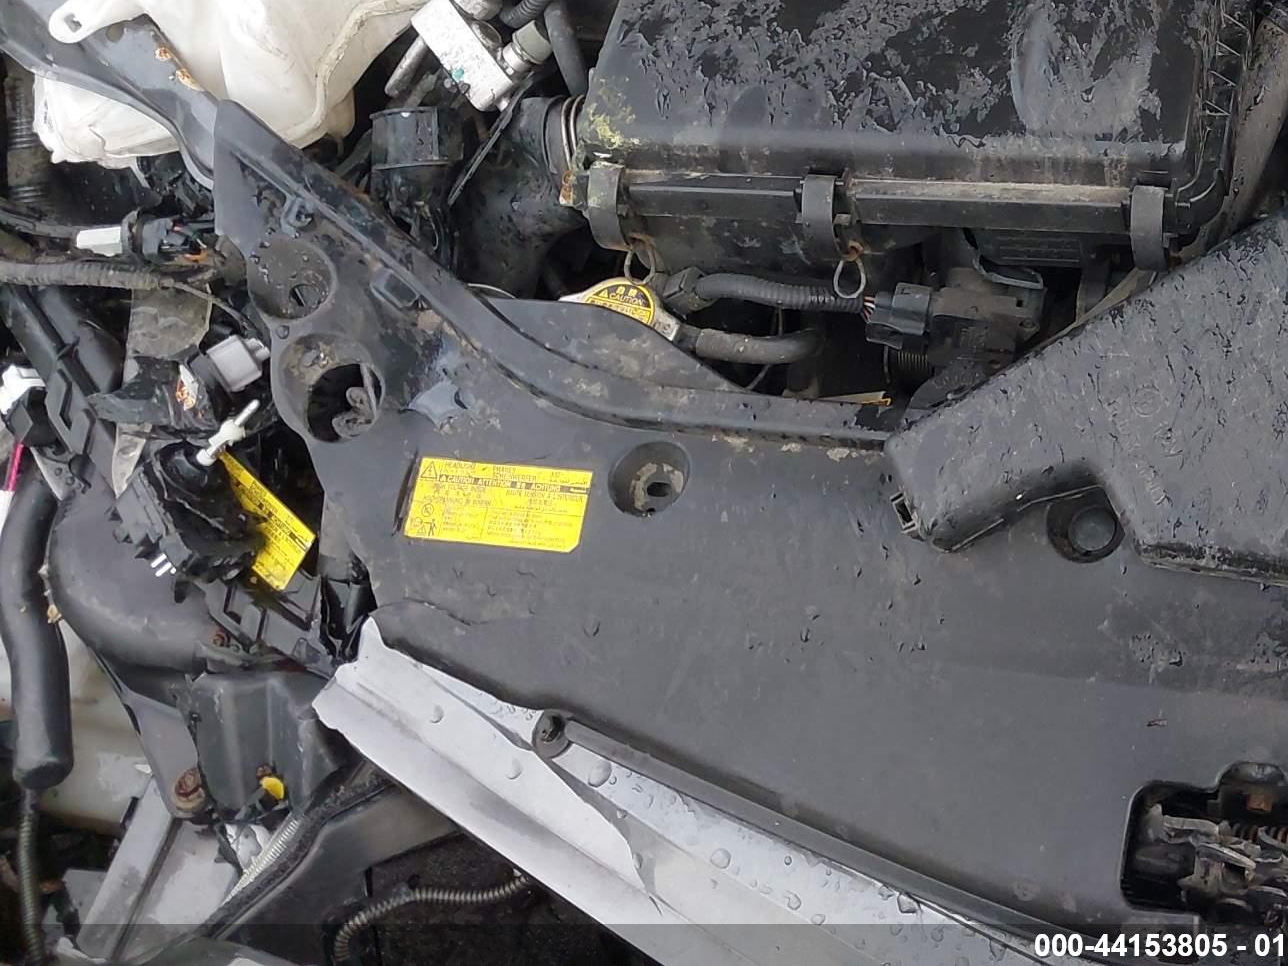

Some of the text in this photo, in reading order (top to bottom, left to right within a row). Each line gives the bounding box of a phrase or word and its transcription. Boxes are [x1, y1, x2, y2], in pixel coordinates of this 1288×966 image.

[608, 292, 645, 306] CAUTION
[448, 476, 475, 484] CAUTION
[478, 479, 511, 488] ATTENTION
[531, 483, 560, 492] ACHTUNG
